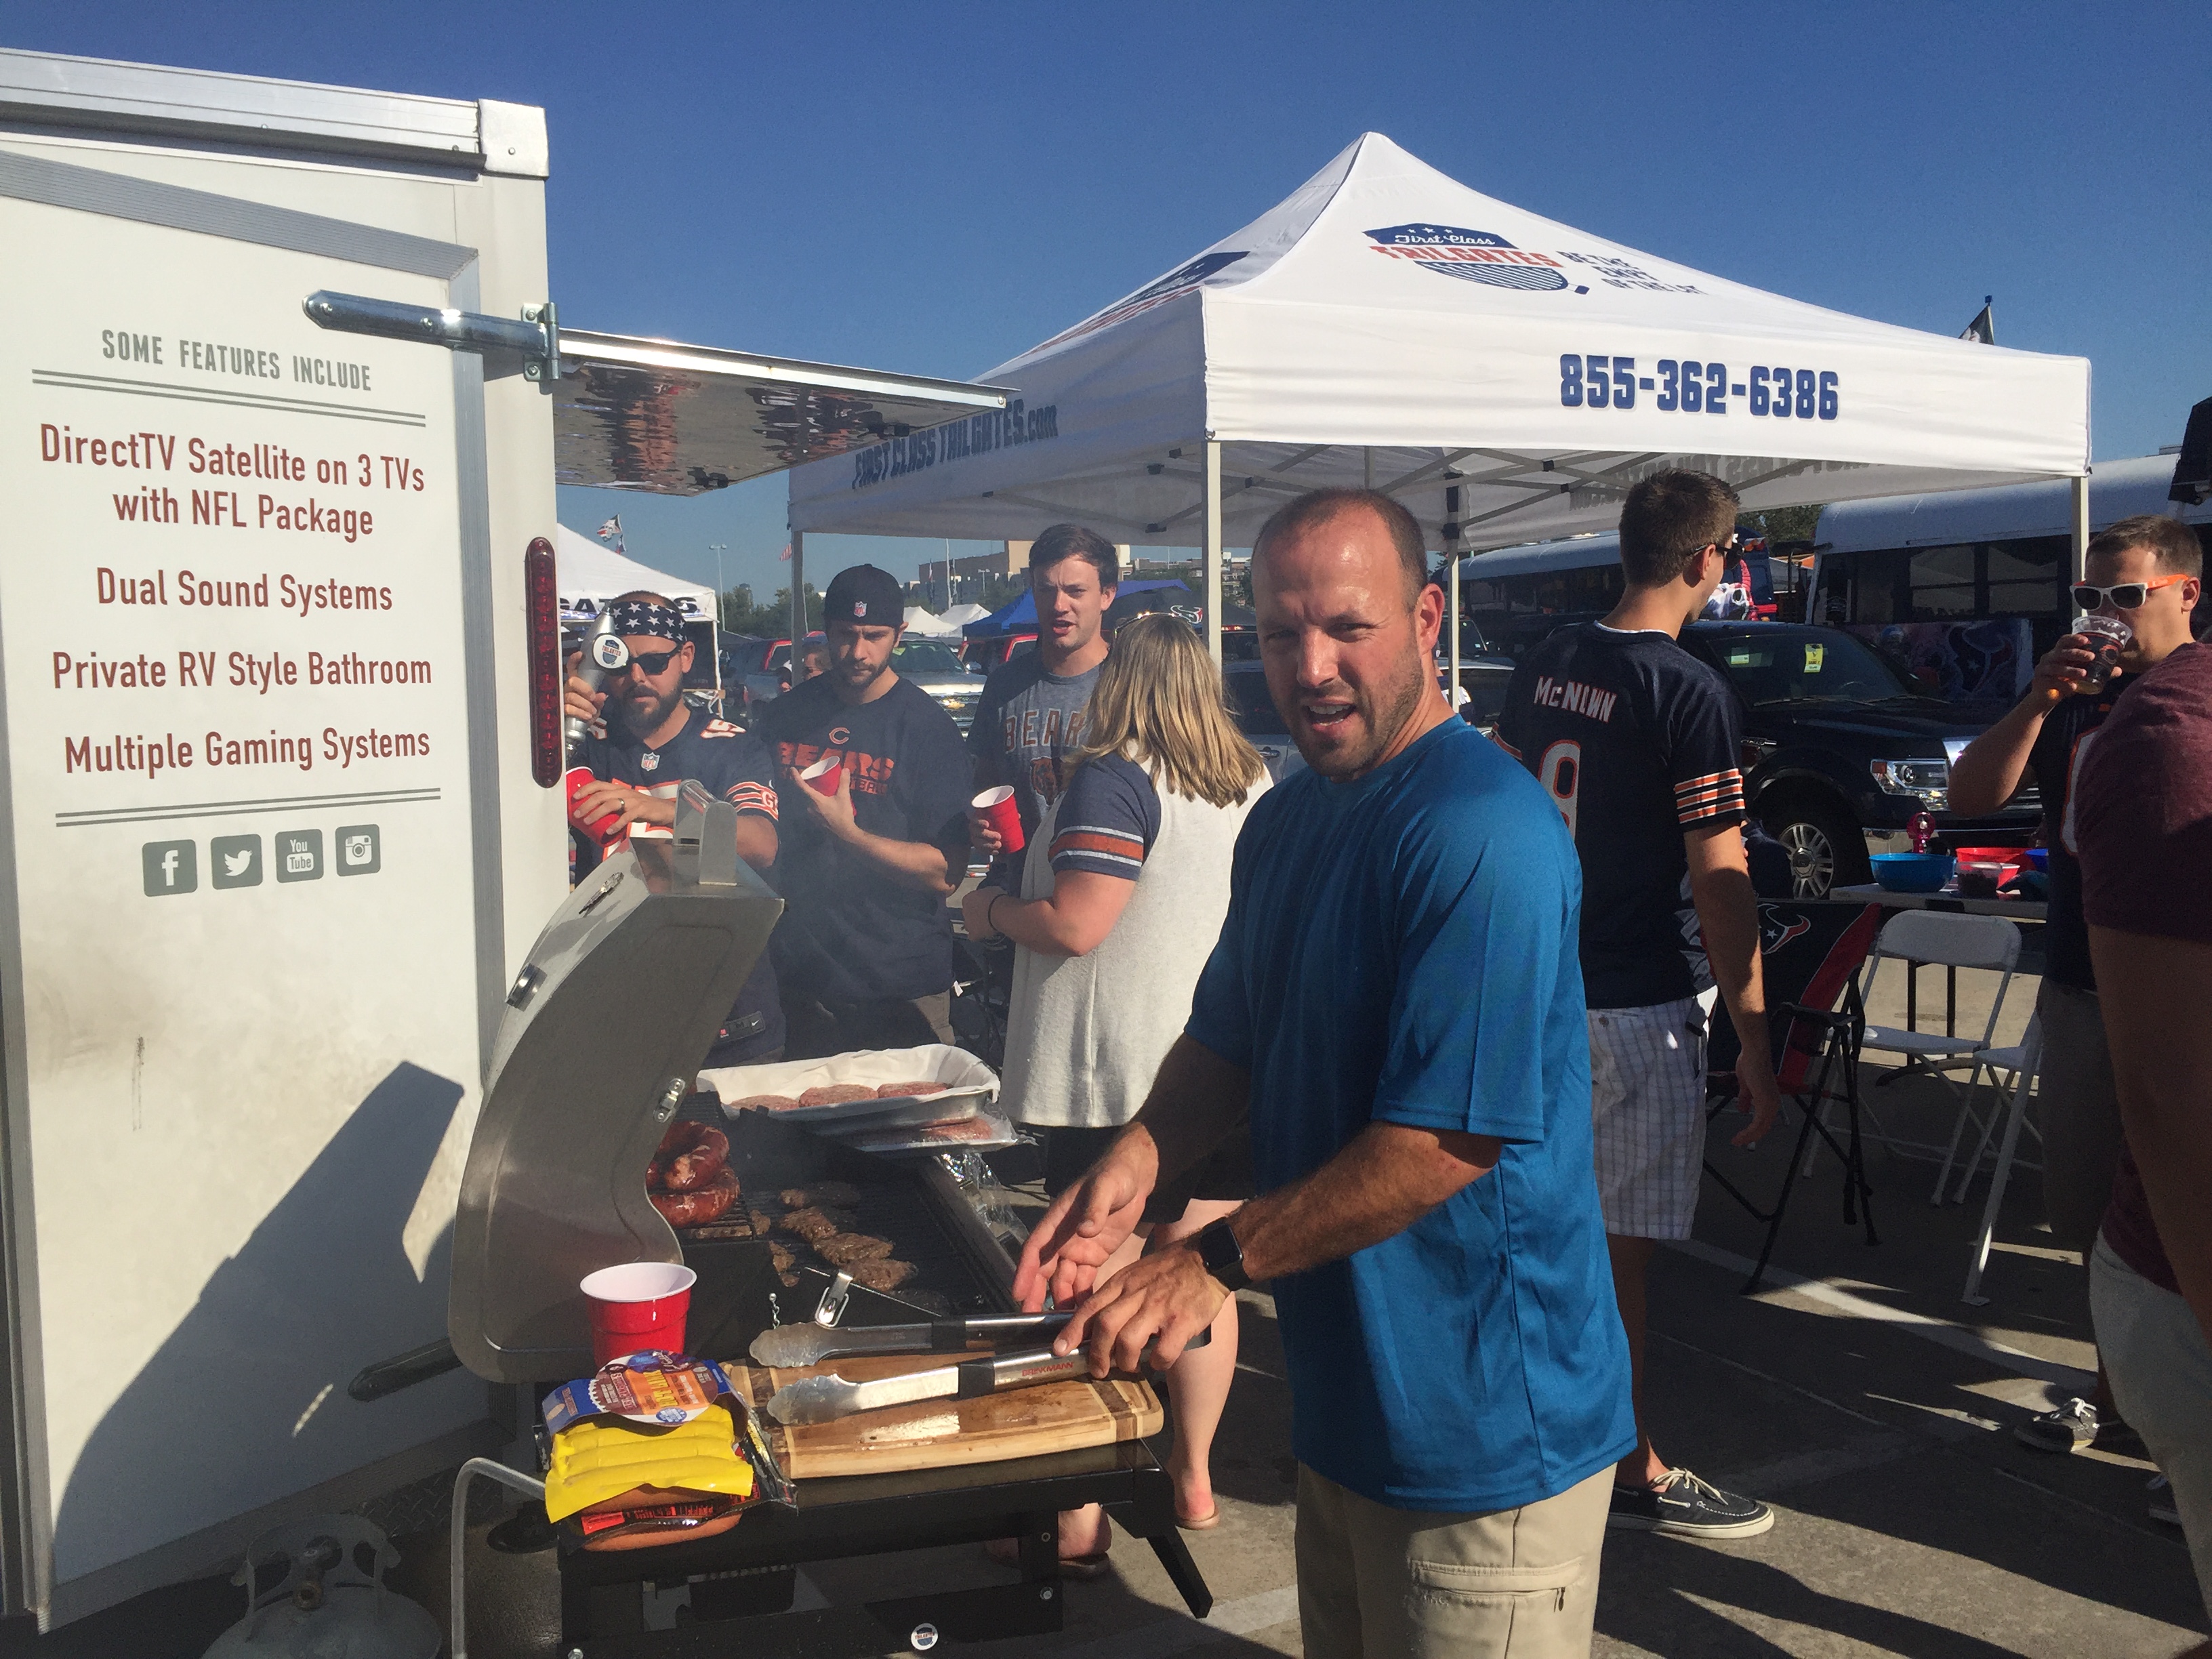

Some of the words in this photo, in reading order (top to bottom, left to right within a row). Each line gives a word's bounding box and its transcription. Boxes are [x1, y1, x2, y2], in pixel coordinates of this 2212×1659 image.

[1368, 246, 1565, 268] TAILGATES
[1395, 234, 1443, 243] First
[1445, 235, 1495, 245] Class
[102, 330, 163, 365] SOME
[180, 340, 279, 379] FEATURES
[293, 356, 371, 390] INCLUDE
[1559, 354, 1839, 421] 855-362-6386
[41, 424, 175, 470] DirectTV
[188, 438, 305, 481] Satellite
[317, 459, 347, 485] on
[359, 454, 371, 487] 3
[380, 456, 424, 491] TVs
[112, 486, 178, 523] with
[192, 489, 247, 527] NFL
[259, 494, 372, 543] Package
[98, 567, 167, 605] Dual
[178, 570, 268, 607] Sound
[281, 574, 392, 617] Systems
[54, 652, 166, 689] Private
[179, 652, 216, 687] RV
[229, 651, 297, 695] Style
[308, 652, 431, 684] Bathroom
[65, 733, 192, 779] Multiple
[206, 730, 312, 771] Gaming
[323, 728, 430, 769] Systems
[1005, 708, 1085, 754] BEAR
[289, 857, 311, 869] Tube
[290, 839, 308, 853] You
[1022, 1361, 1073, 1377] BRINKMANN
